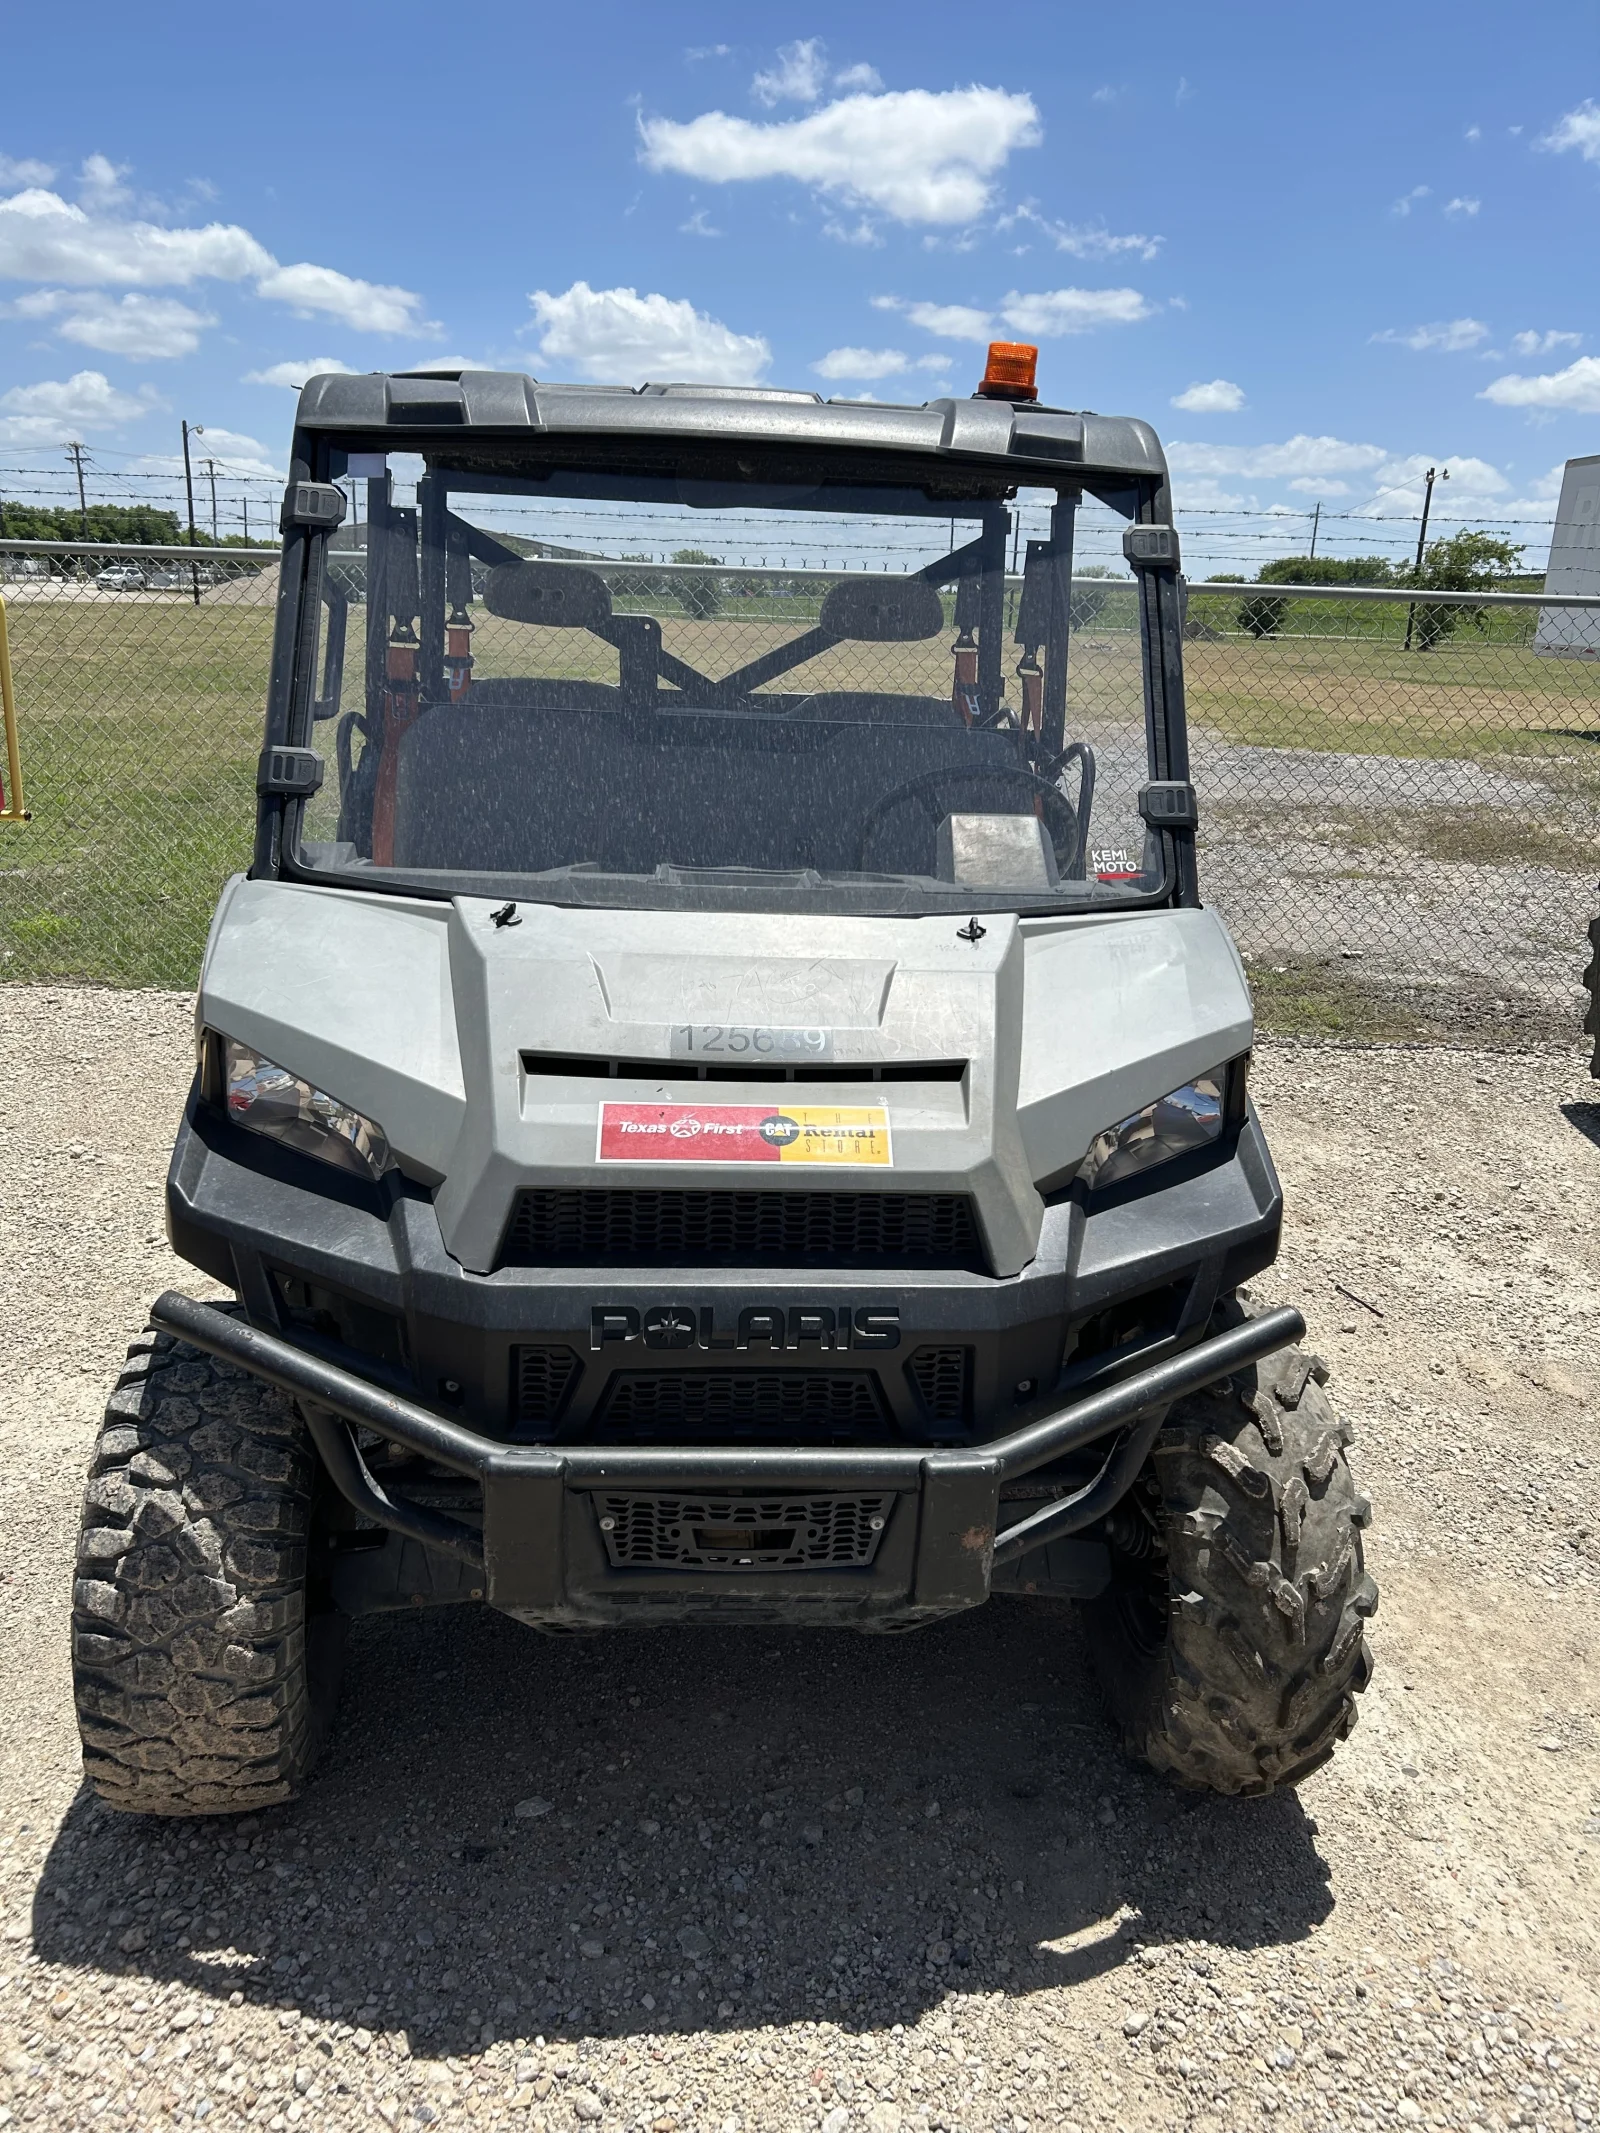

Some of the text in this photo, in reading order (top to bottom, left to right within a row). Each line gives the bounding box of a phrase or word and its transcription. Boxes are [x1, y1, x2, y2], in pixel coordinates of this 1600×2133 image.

[1091, 850, 1128, 861] KEMI
[1093, 861, 1137, 873] MOTO
[619, 1121, 743, 1134] Texas First
[765, 1122, 792, 1137] CAT
[591, 1306, 900, 1350] POLARIS
